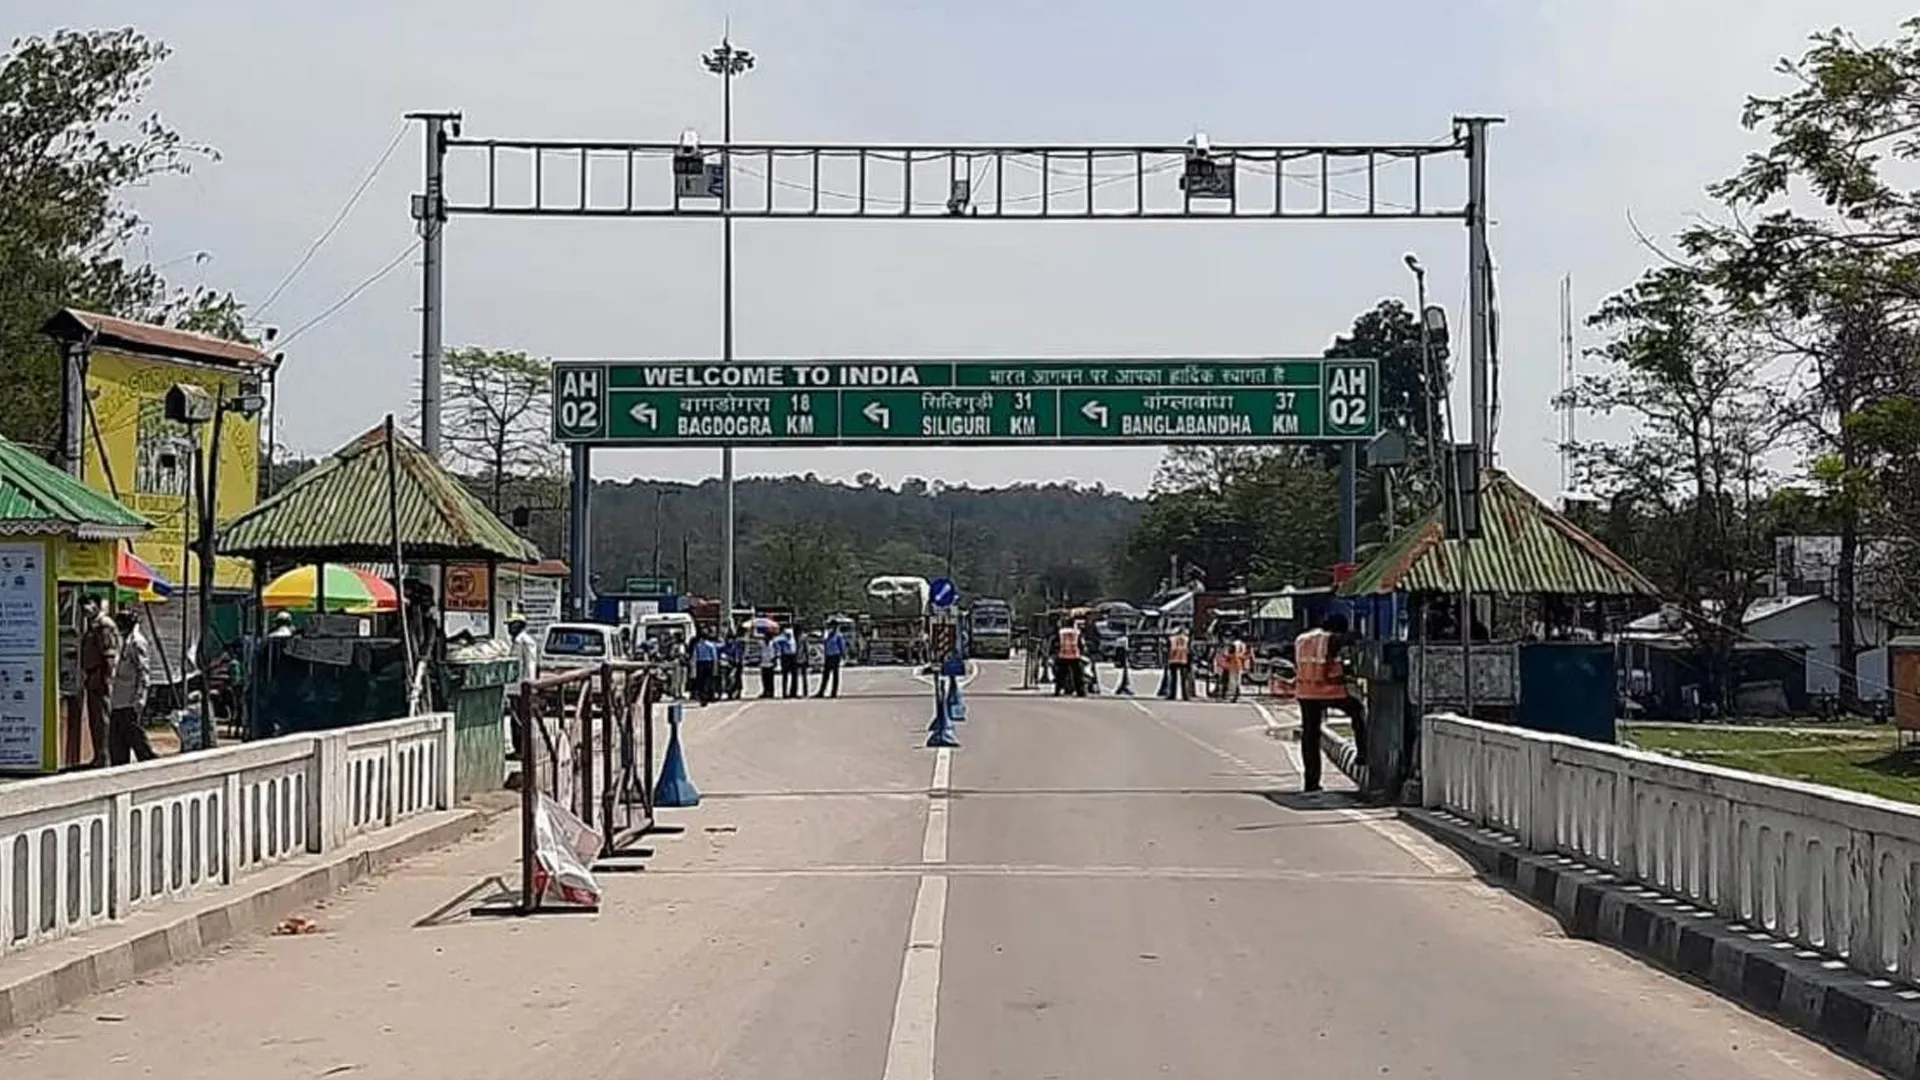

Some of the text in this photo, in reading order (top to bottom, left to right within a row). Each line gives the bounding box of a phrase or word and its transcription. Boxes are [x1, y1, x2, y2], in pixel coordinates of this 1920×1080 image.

[563, 371, 598, 397] AH
[644, 366, 919, 386] WELCOME TO INDIA
[989, 370, 1025, 384] भारत
[1032, 370, 1082, 384] आगमन
[1090, 370, 1108, 384] पर
[1115, 369, 1162, 384] आपका
[1221, 368, 1266, 384] स्वागत
[1272, 365, 1285, 384] है
[1330, 368, 1366, 395] AH
[791, 393, 811, 412] 18
[1015, 392, 1032, 410] 31
[1275, 392, 1296, 410] 37
[1329, 398, 1366, 425] 02
[562, 401, 598, 427] 02
[1122, 413, 1299, 435] BANGLABANDHA KM
[677, 415, 814, 436] BAGDOGRA KM
[922, 415, 1036, 436] SILIGURI KM
